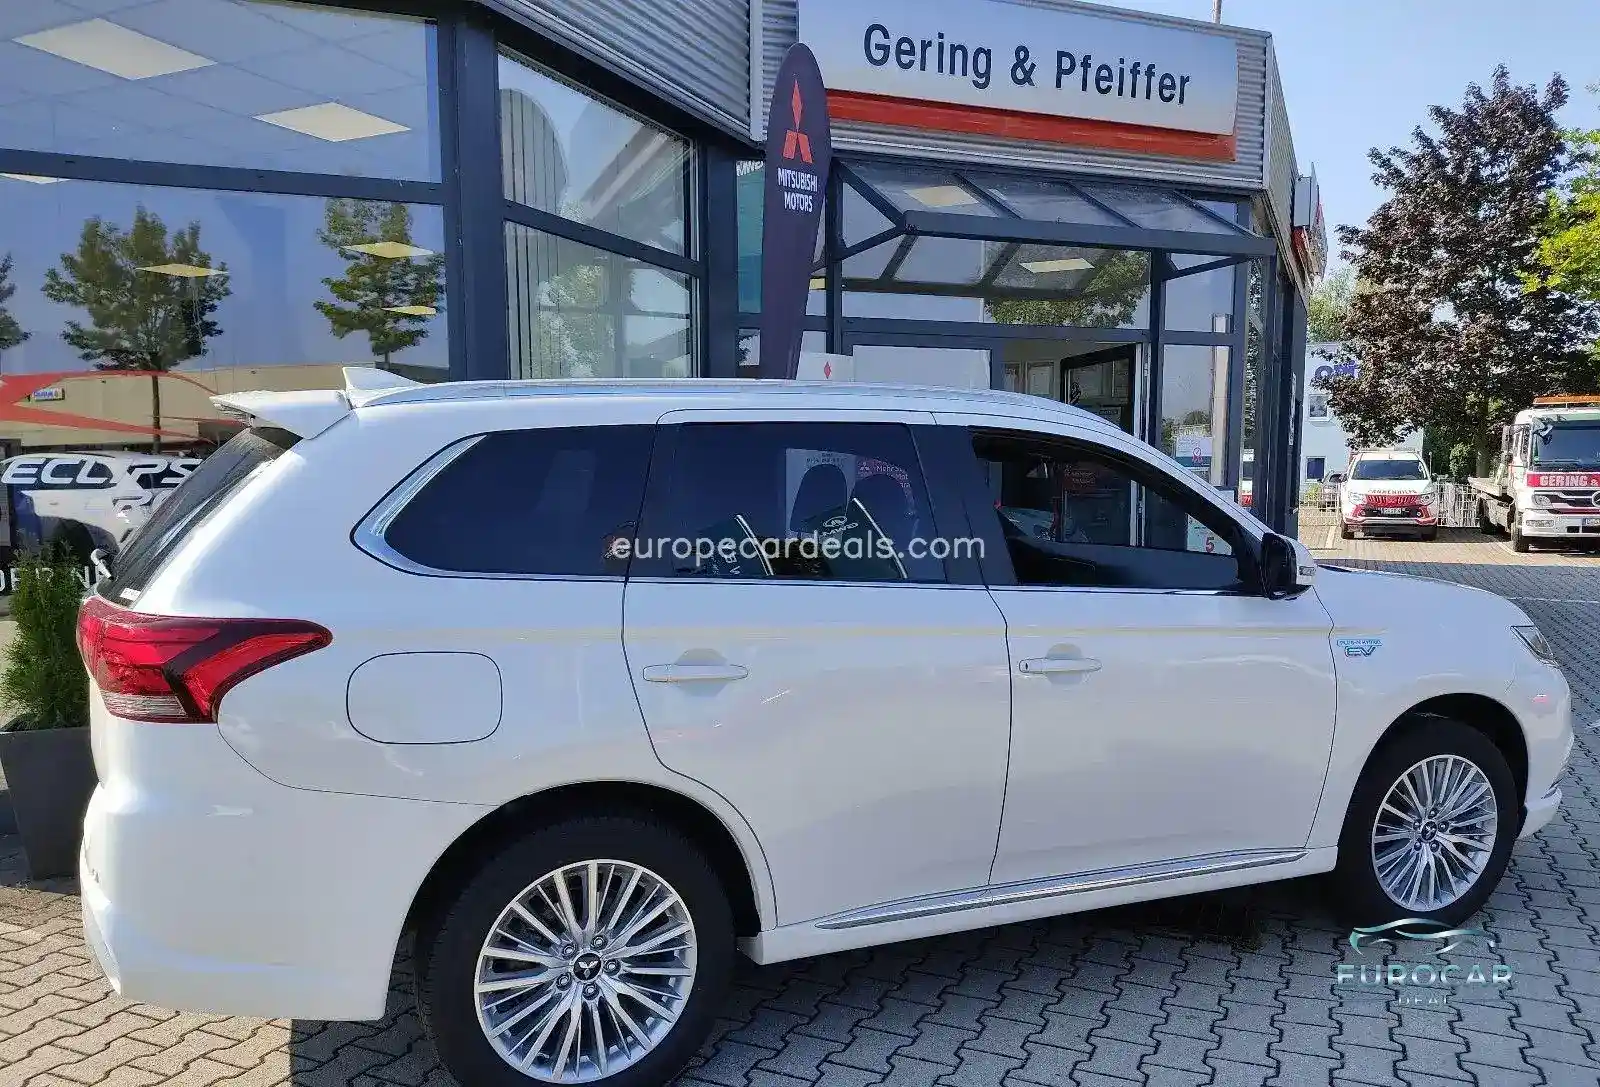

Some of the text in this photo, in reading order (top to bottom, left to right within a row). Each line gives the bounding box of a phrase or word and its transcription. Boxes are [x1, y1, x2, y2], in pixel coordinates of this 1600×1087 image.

[864, 23, 1190, 105] Gering & Pfeiffer
[777, 167, 818, 192] MITSUBISHI
[784, 191, 813, 213] MOTORS
[1540, 475, 1588, 487] GERING
[1344, 646, 1376, 657] EV
